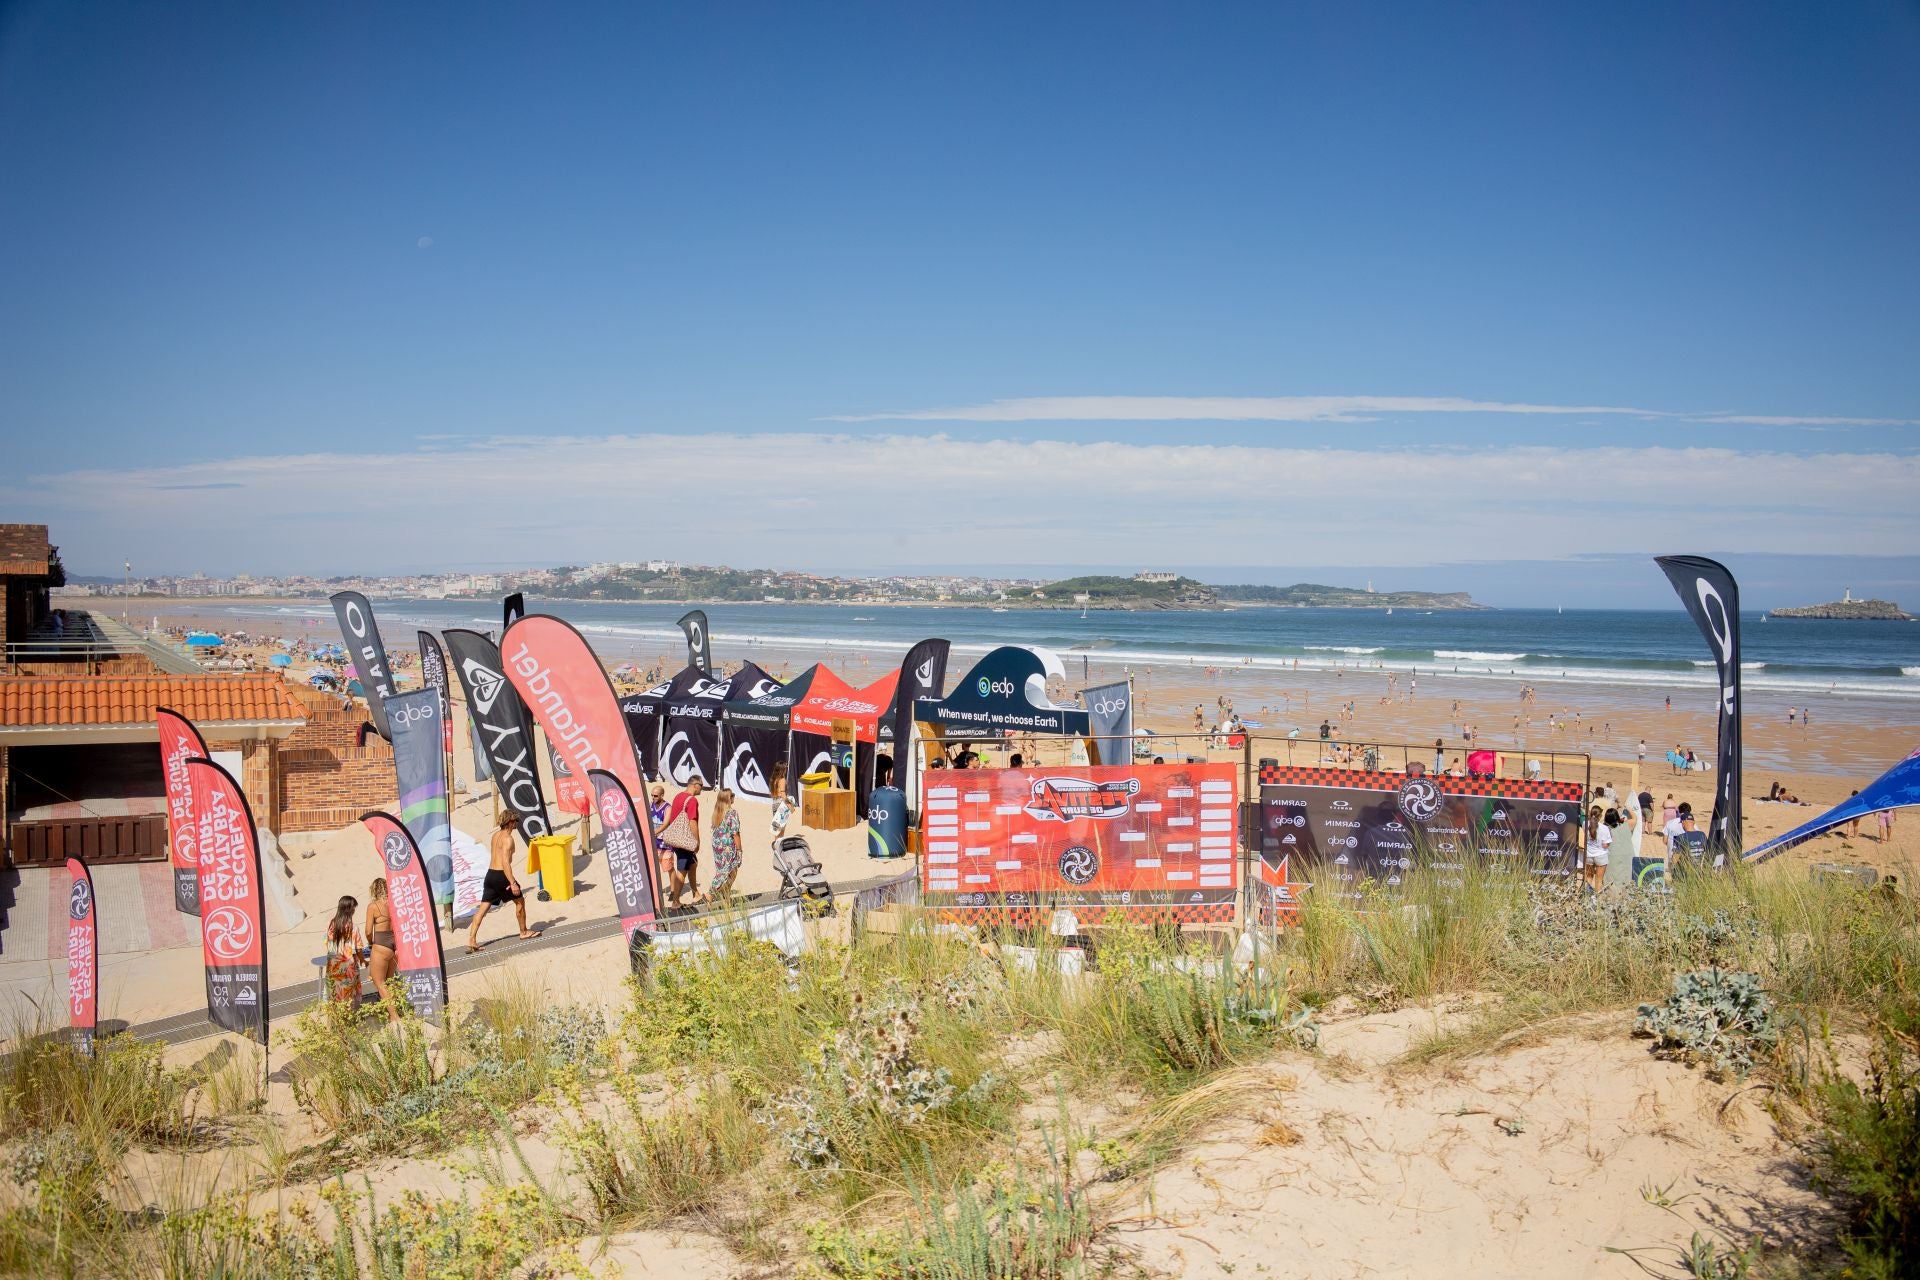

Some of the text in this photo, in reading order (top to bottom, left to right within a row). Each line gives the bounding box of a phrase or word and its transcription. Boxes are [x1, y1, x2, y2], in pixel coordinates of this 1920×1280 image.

[991, 676, 1015, 698] edp
[938, 708, 1058, 728] When we surf, we choose Earth
